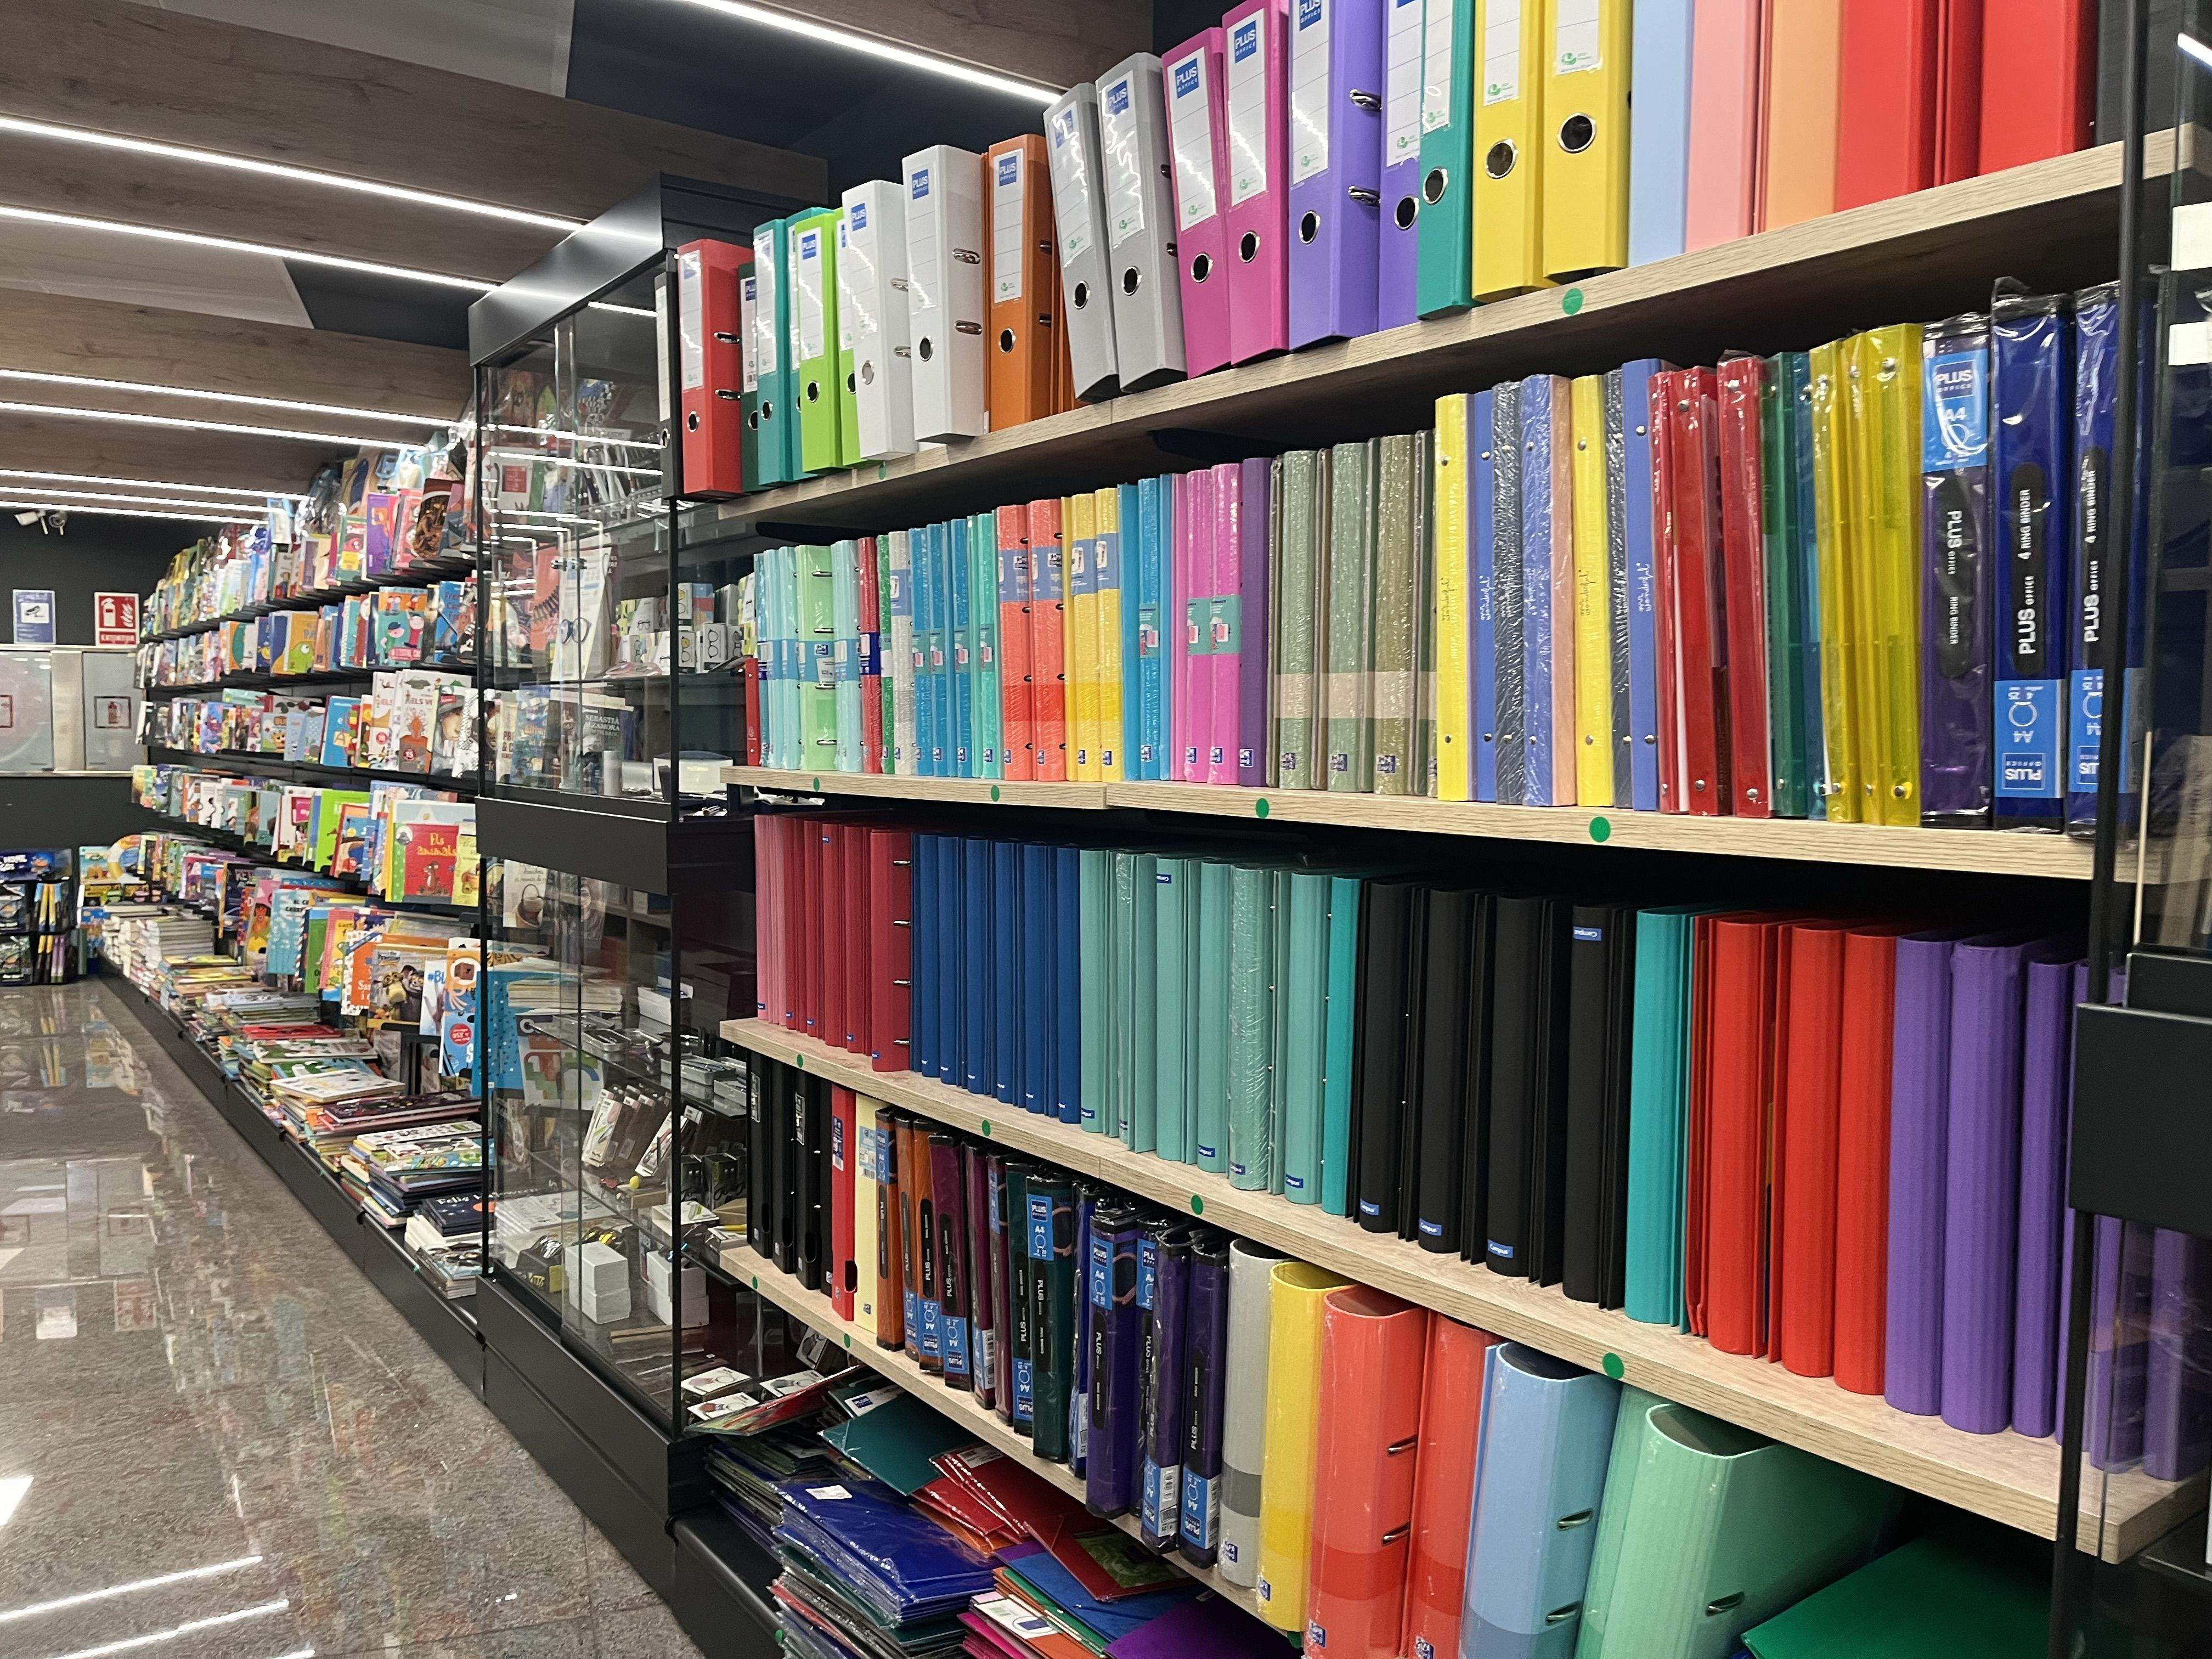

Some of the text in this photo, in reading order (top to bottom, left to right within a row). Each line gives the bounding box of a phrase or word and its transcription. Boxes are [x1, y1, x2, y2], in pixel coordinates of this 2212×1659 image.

[1235, 29, 1255, 49] PLUS
[1176, 66, 1197, 86] PLUS
[1000, 162, 1017, 176] PLUS
[912, 176, 928, 189] PLUS
[851, 208, 866, 220] PLUS
[1934, 369, 1973, 386] PLUS
[1944, 407, 1967, 422] A4
[2086, 470, 2096, 506] BINDER
[2020, 489, 2030, 524] BINDER
[2086, 508, 2096, 532] RING
[1947, 510, 1962, 548] PLUS
[2020, 526, 2031, 549] RING
[1949, 596, 1959, 614] RING
[2084, 594, 2099, 642] PLUS
[1949, 617, 1959, 645] BINDER
[2018, 608, 2036, 654] PLUS
[2013, 730, 2034, 743] A4
[2005, 769, 2041, 780] PLUS
[430, 832, 444, 845] Els
[1574, 929, 1598, 938] Campu
[1032, 1204, 1046, 1213] PLUS
[1035, 1225, 1045, 1233] A4
[1093, 1246, 1107, 1258] PLUS
[1095, 1270, 1104, 1279] A4
[1020, 1384, 1030, 1392] A4
[1018, 1403, 1034, 1412] PLUS
[1187, 1499, 1198, 1511] A4
[1185, 1521, 1200, 1535] PLUS
